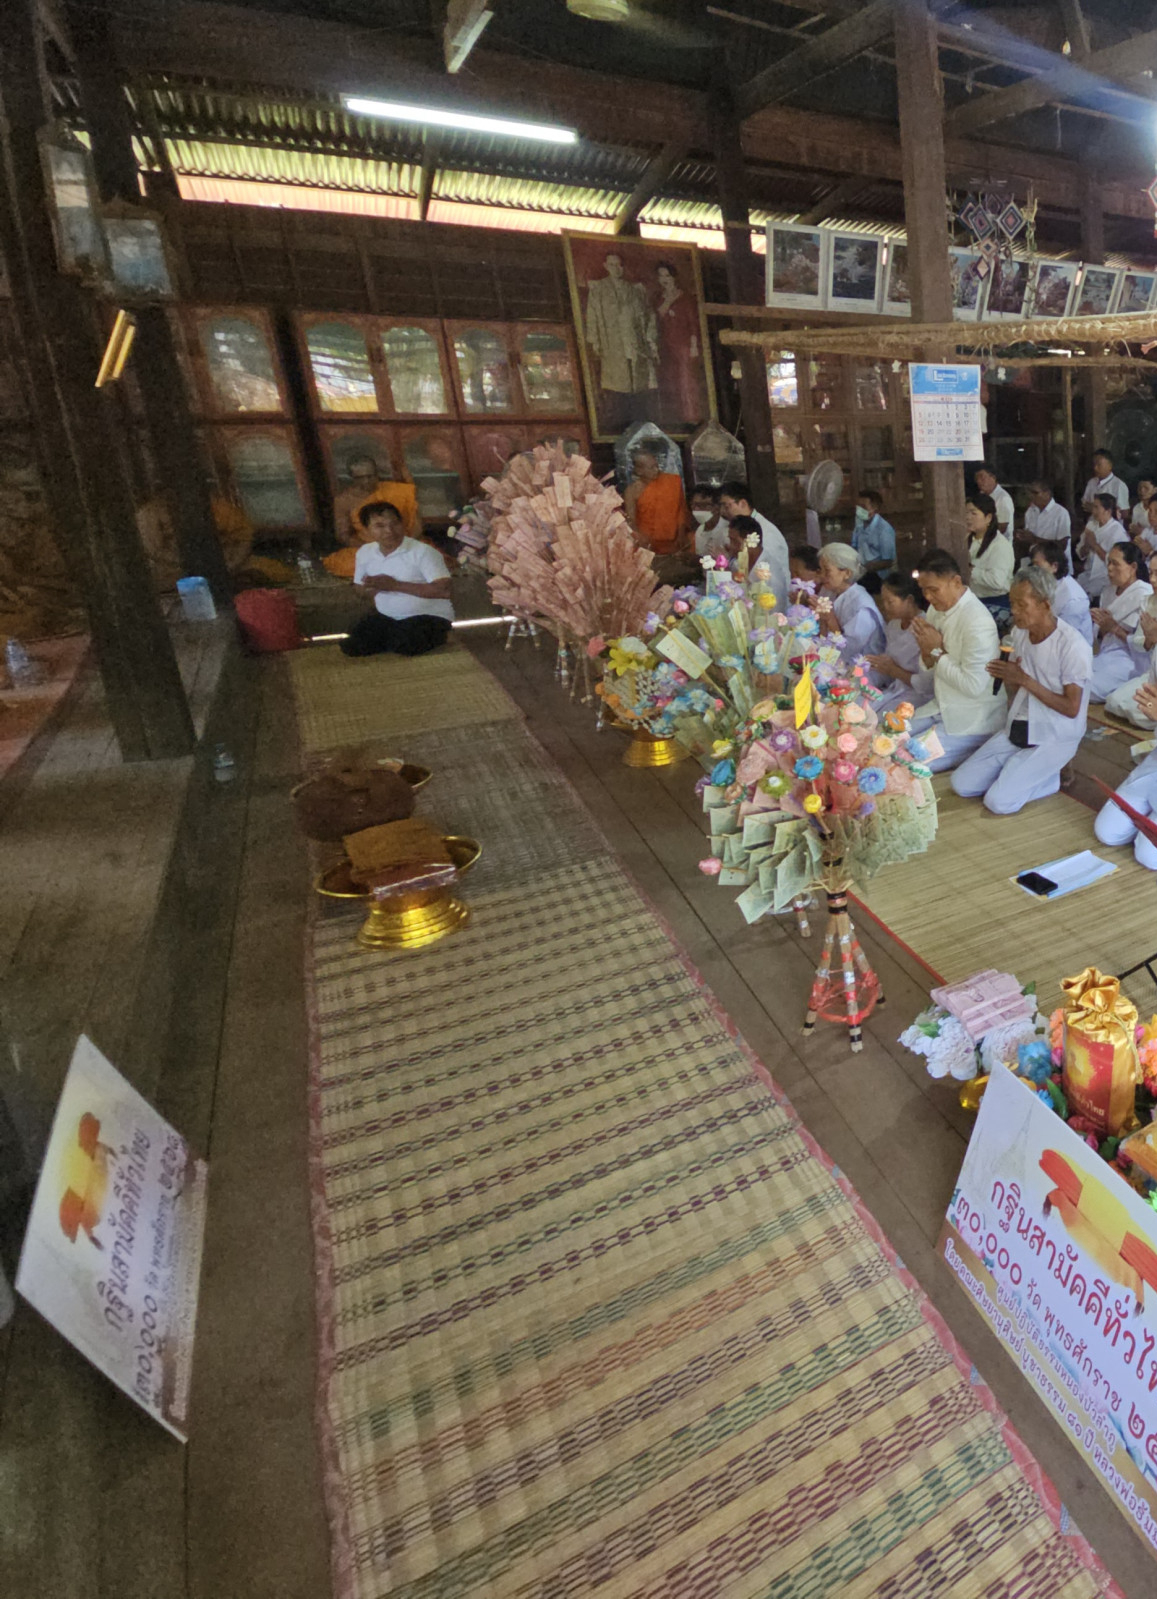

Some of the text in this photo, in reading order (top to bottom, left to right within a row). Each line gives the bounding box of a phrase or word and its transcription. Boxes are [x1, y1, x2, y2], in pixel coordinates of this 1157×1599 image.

[956, 1195, 1023, 1286] ๓๐,๐๐๐
[1026, 1277, 1042, 1311] วัด
[1044, 1306, 1122, 1412] พุทธศักราช
[997, 1285, 1116, 1452] ศูนย์ปฏิบัติธรรมหนองบัวลำภู
[1022, 1349, 1067, 1412] บูชาธรรม
[1083, 1427, 1095, 1450] ปี
